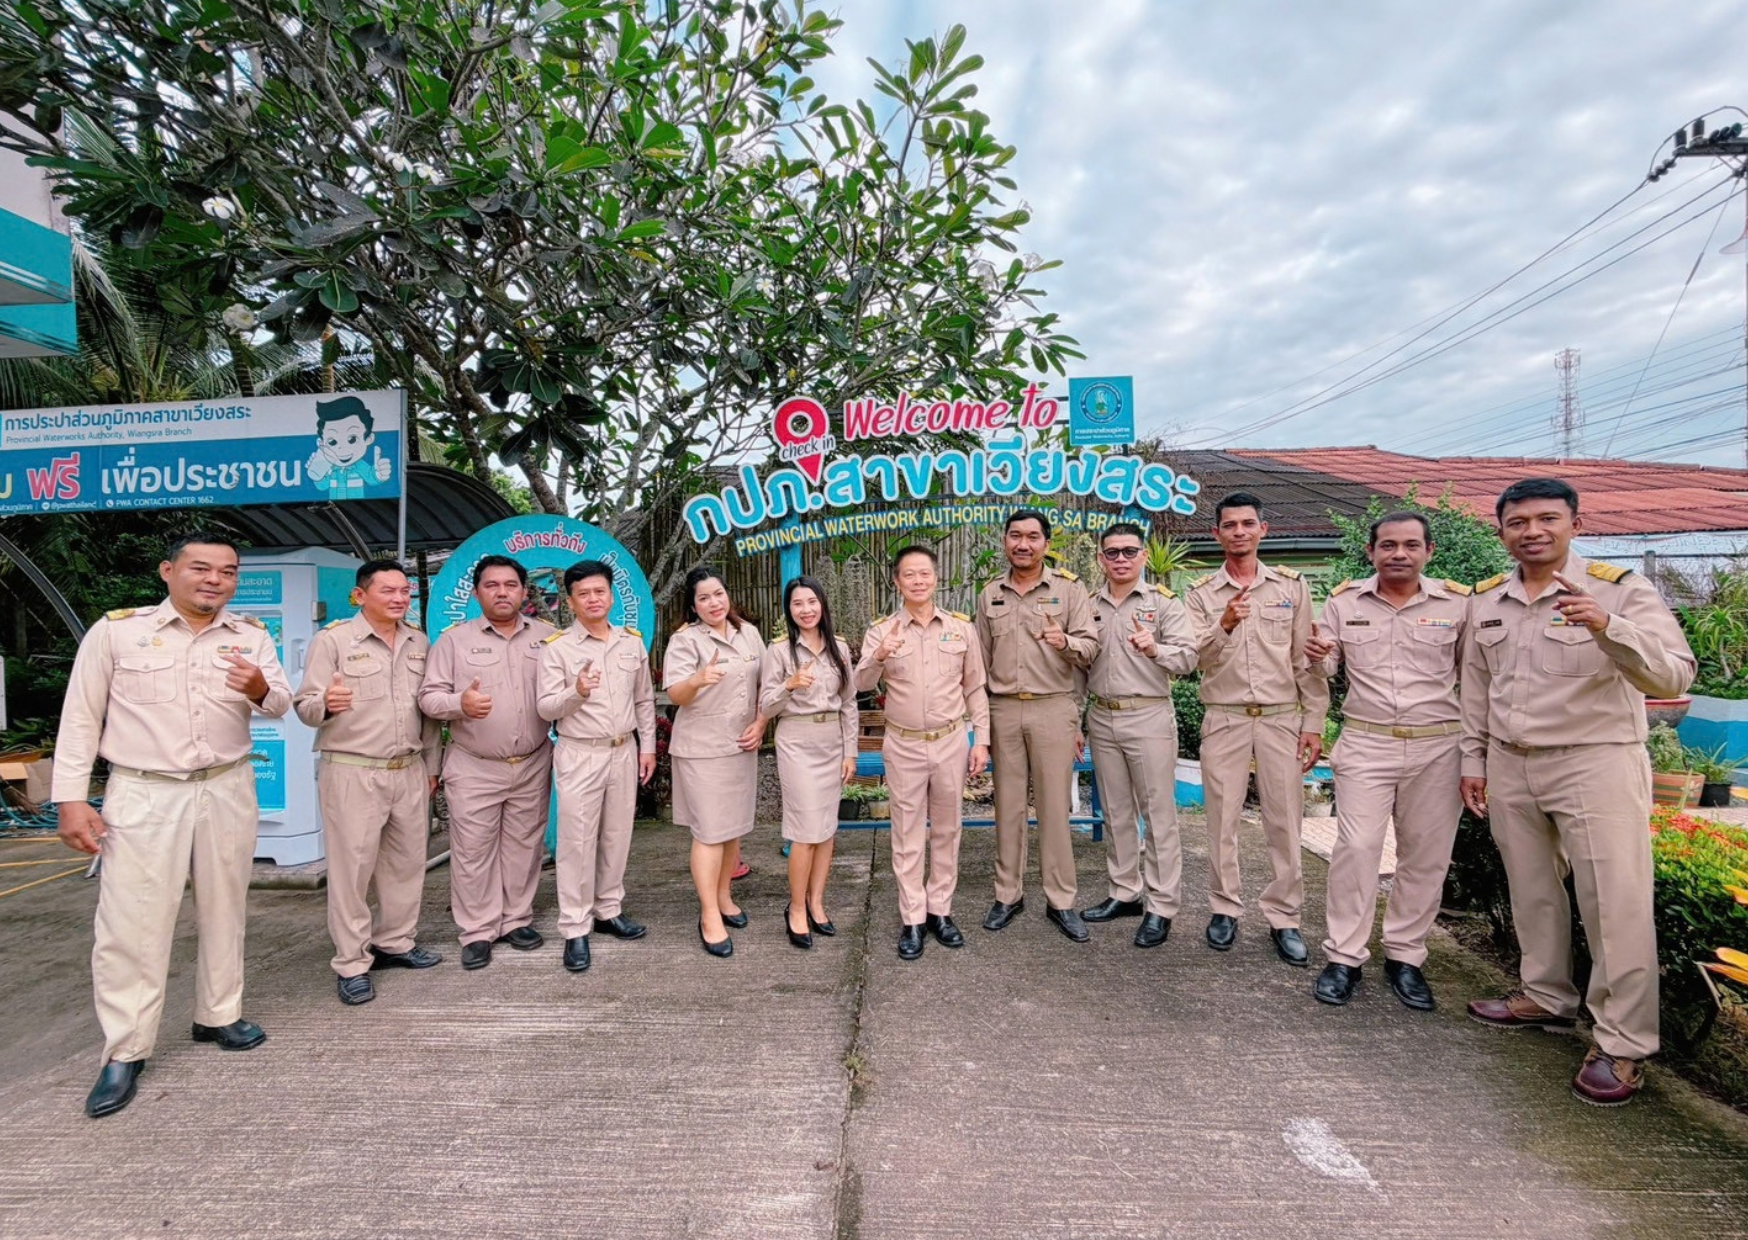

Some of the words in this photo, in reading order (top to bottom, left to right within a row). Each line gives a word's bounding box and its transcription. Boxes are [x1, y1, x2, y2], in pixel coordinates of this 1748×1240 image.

[5, 405, 252, 431] การประปาส่วนภูมิภาคสาขาเวียงสระ
[845, 391, 1010, 440] Welcome
[1020, 382, 1058, 429] to
[6, 434, 41, 444] Provincial
[43, 432, 86, 442] Waterworks
[164, 427, 192, 437] Branch
[782, 436, 818, 459] check
[822, 434, 835, 450] in
[27, 451, 80, 499] ฟรี
[101, 447, 301, 494] เพื่อประชาชน
[116, 499, 132, 507] PWA
[133, 498, 167, 507] CONTACT
[168, 497, 196, 506] CENTER
[198, 496, 214, 504] 1662
[503, 521, 587, 554] บริการทั่วถึง
[736, 521, 823, 556] PROVINCIAL
[825, 510, 918, 537] WATERWORK
[923, 506, 1006, 526] AUTHORITY
